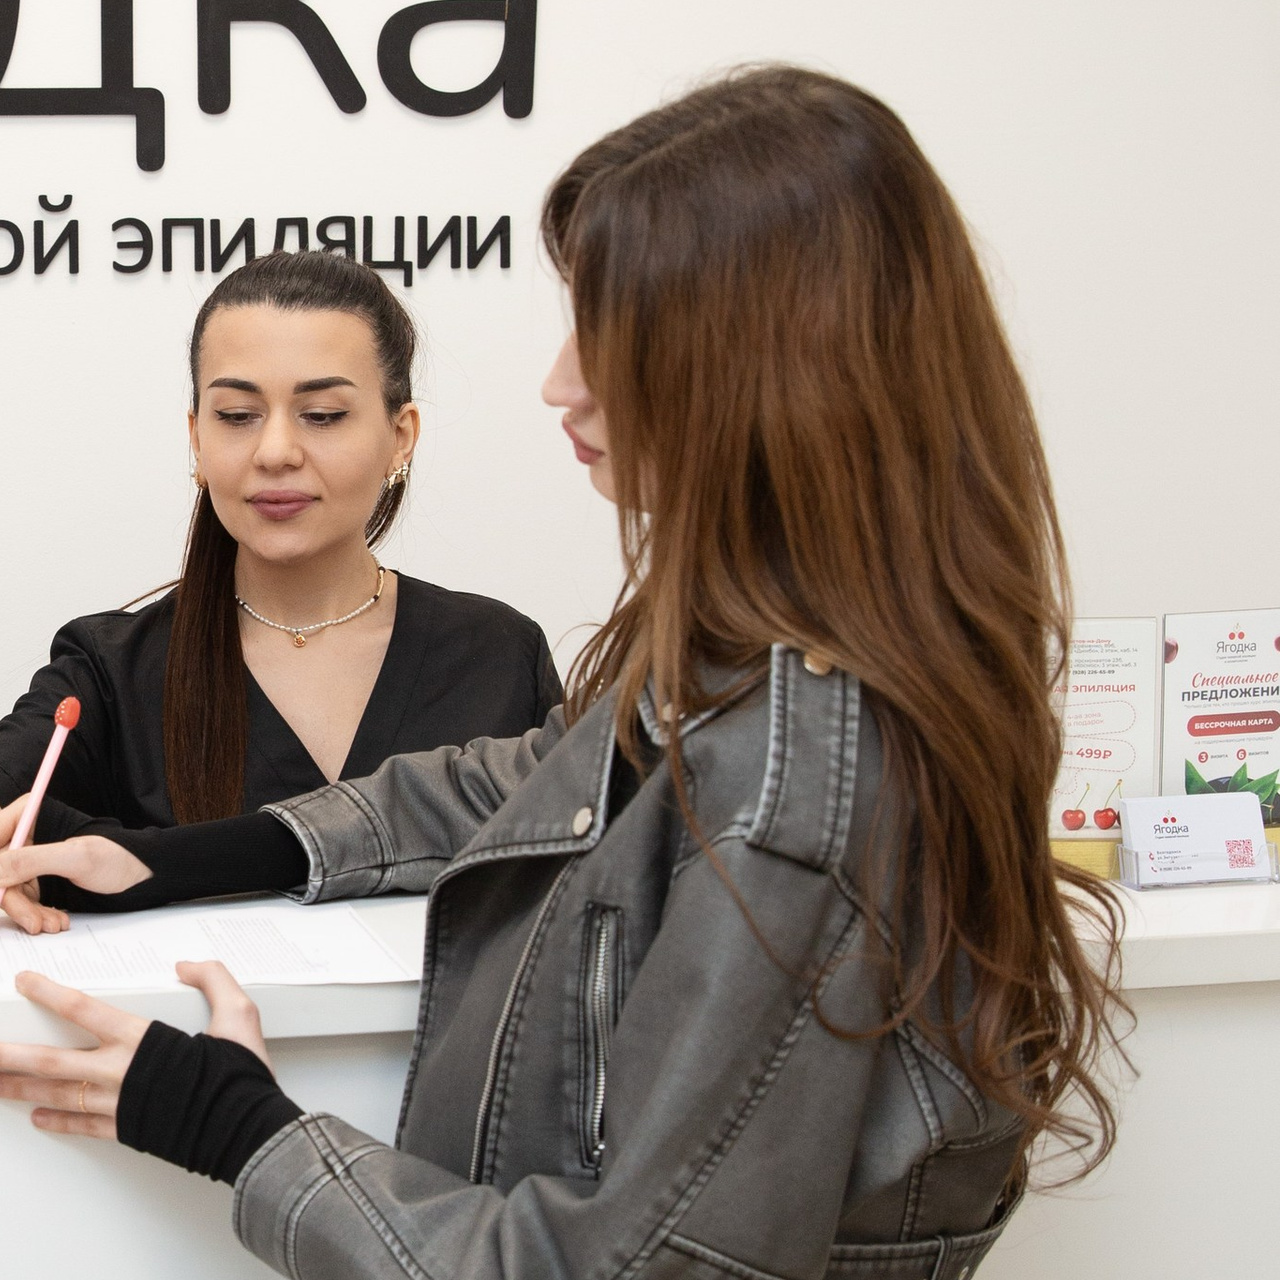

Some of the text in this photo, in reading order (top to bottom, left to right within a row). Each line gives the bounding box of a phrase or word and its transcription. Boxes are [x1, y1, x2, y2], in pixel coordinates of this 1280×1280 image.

[112, 214, 511, 287] эпиляции
[1216, 641, 1257, 654] Ягодка
[1192, 672, 1280, 688] Специальное
[1072, 684, 1136, 693] ЭПИЛЯЦИЯ
[1182, 686, 1280, 701] ПРЕДЛОЖЕНИ
[1195, 718, 1273, 730] БЕССРОЧНАЯ КАРТА
[1153, 824, 1189, 835] Ягодка
